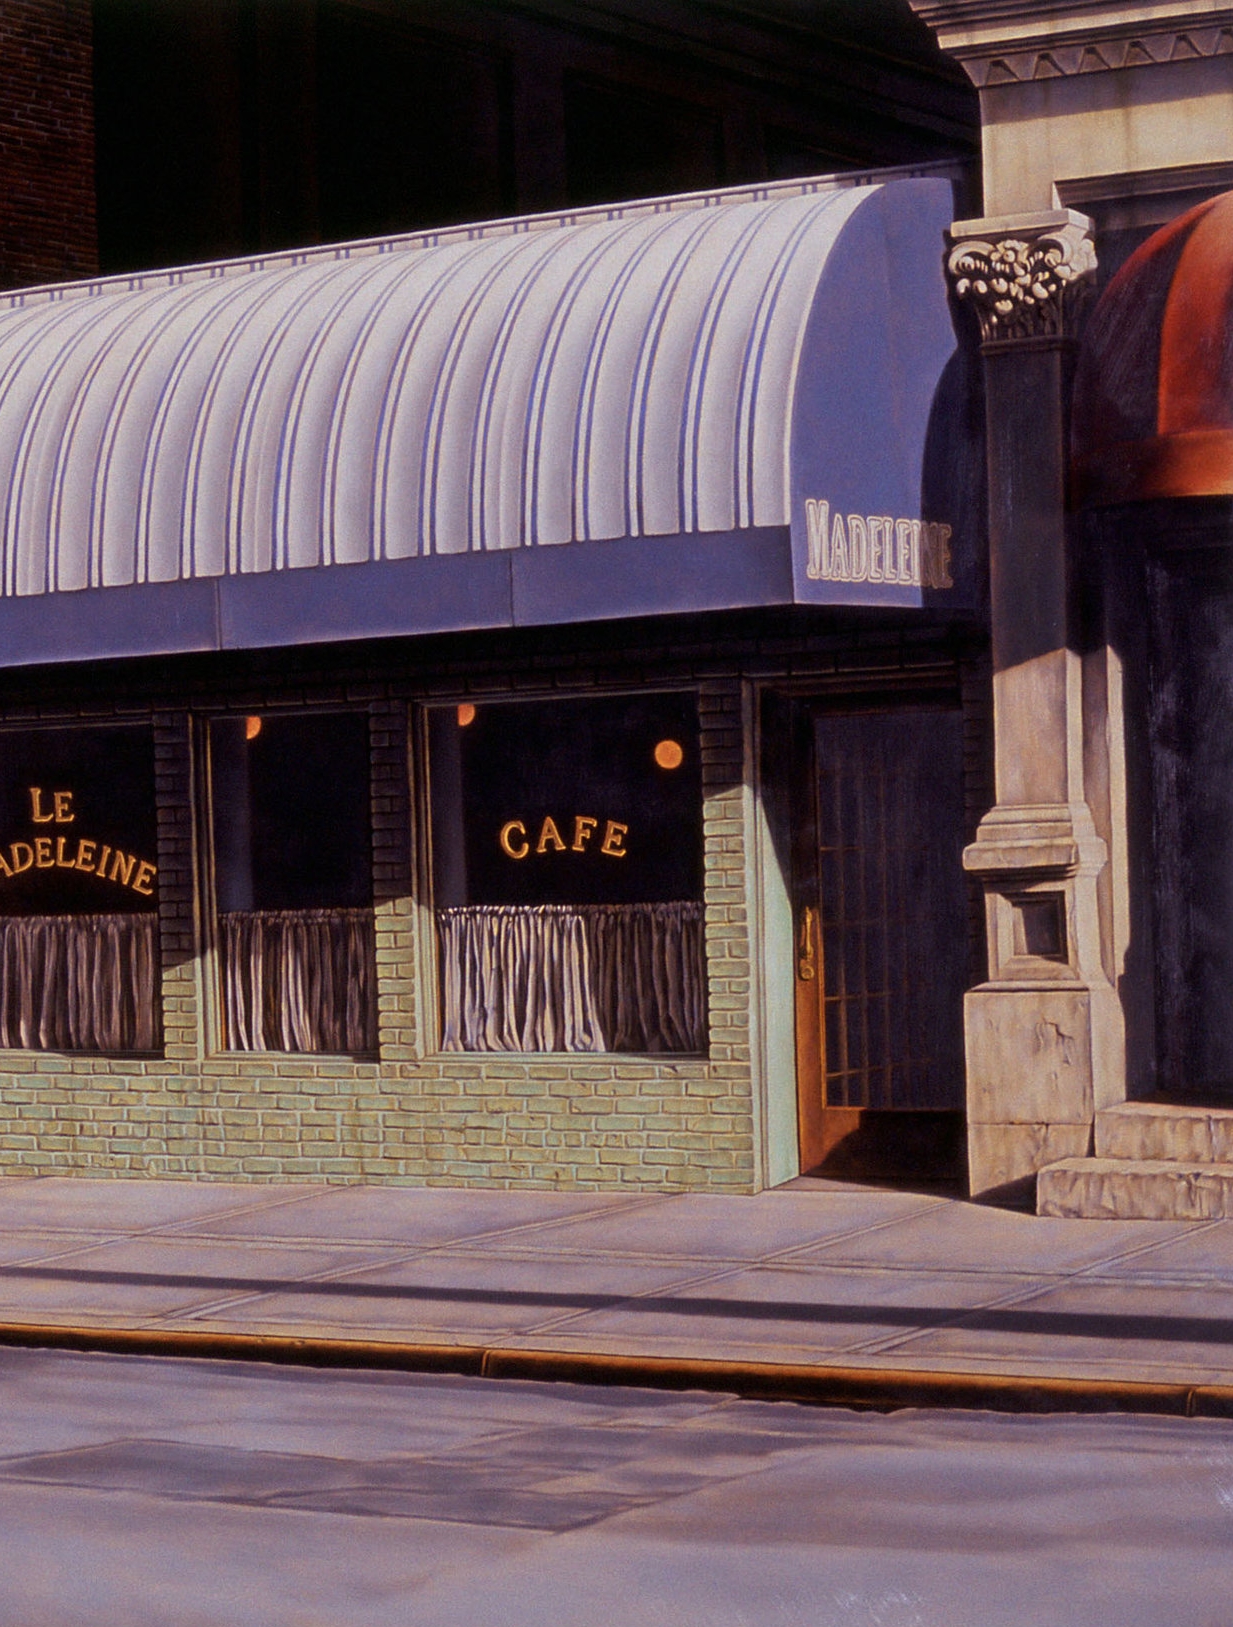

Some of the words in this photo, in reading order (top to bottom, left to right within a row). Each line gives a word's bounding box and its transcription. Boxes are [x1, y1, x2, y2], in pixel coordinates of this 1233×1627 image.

[805, 498, 954, 589] MADELEINE
[30, 787, 75, 823] LE
[500, 816, 628, 859] CAFE
